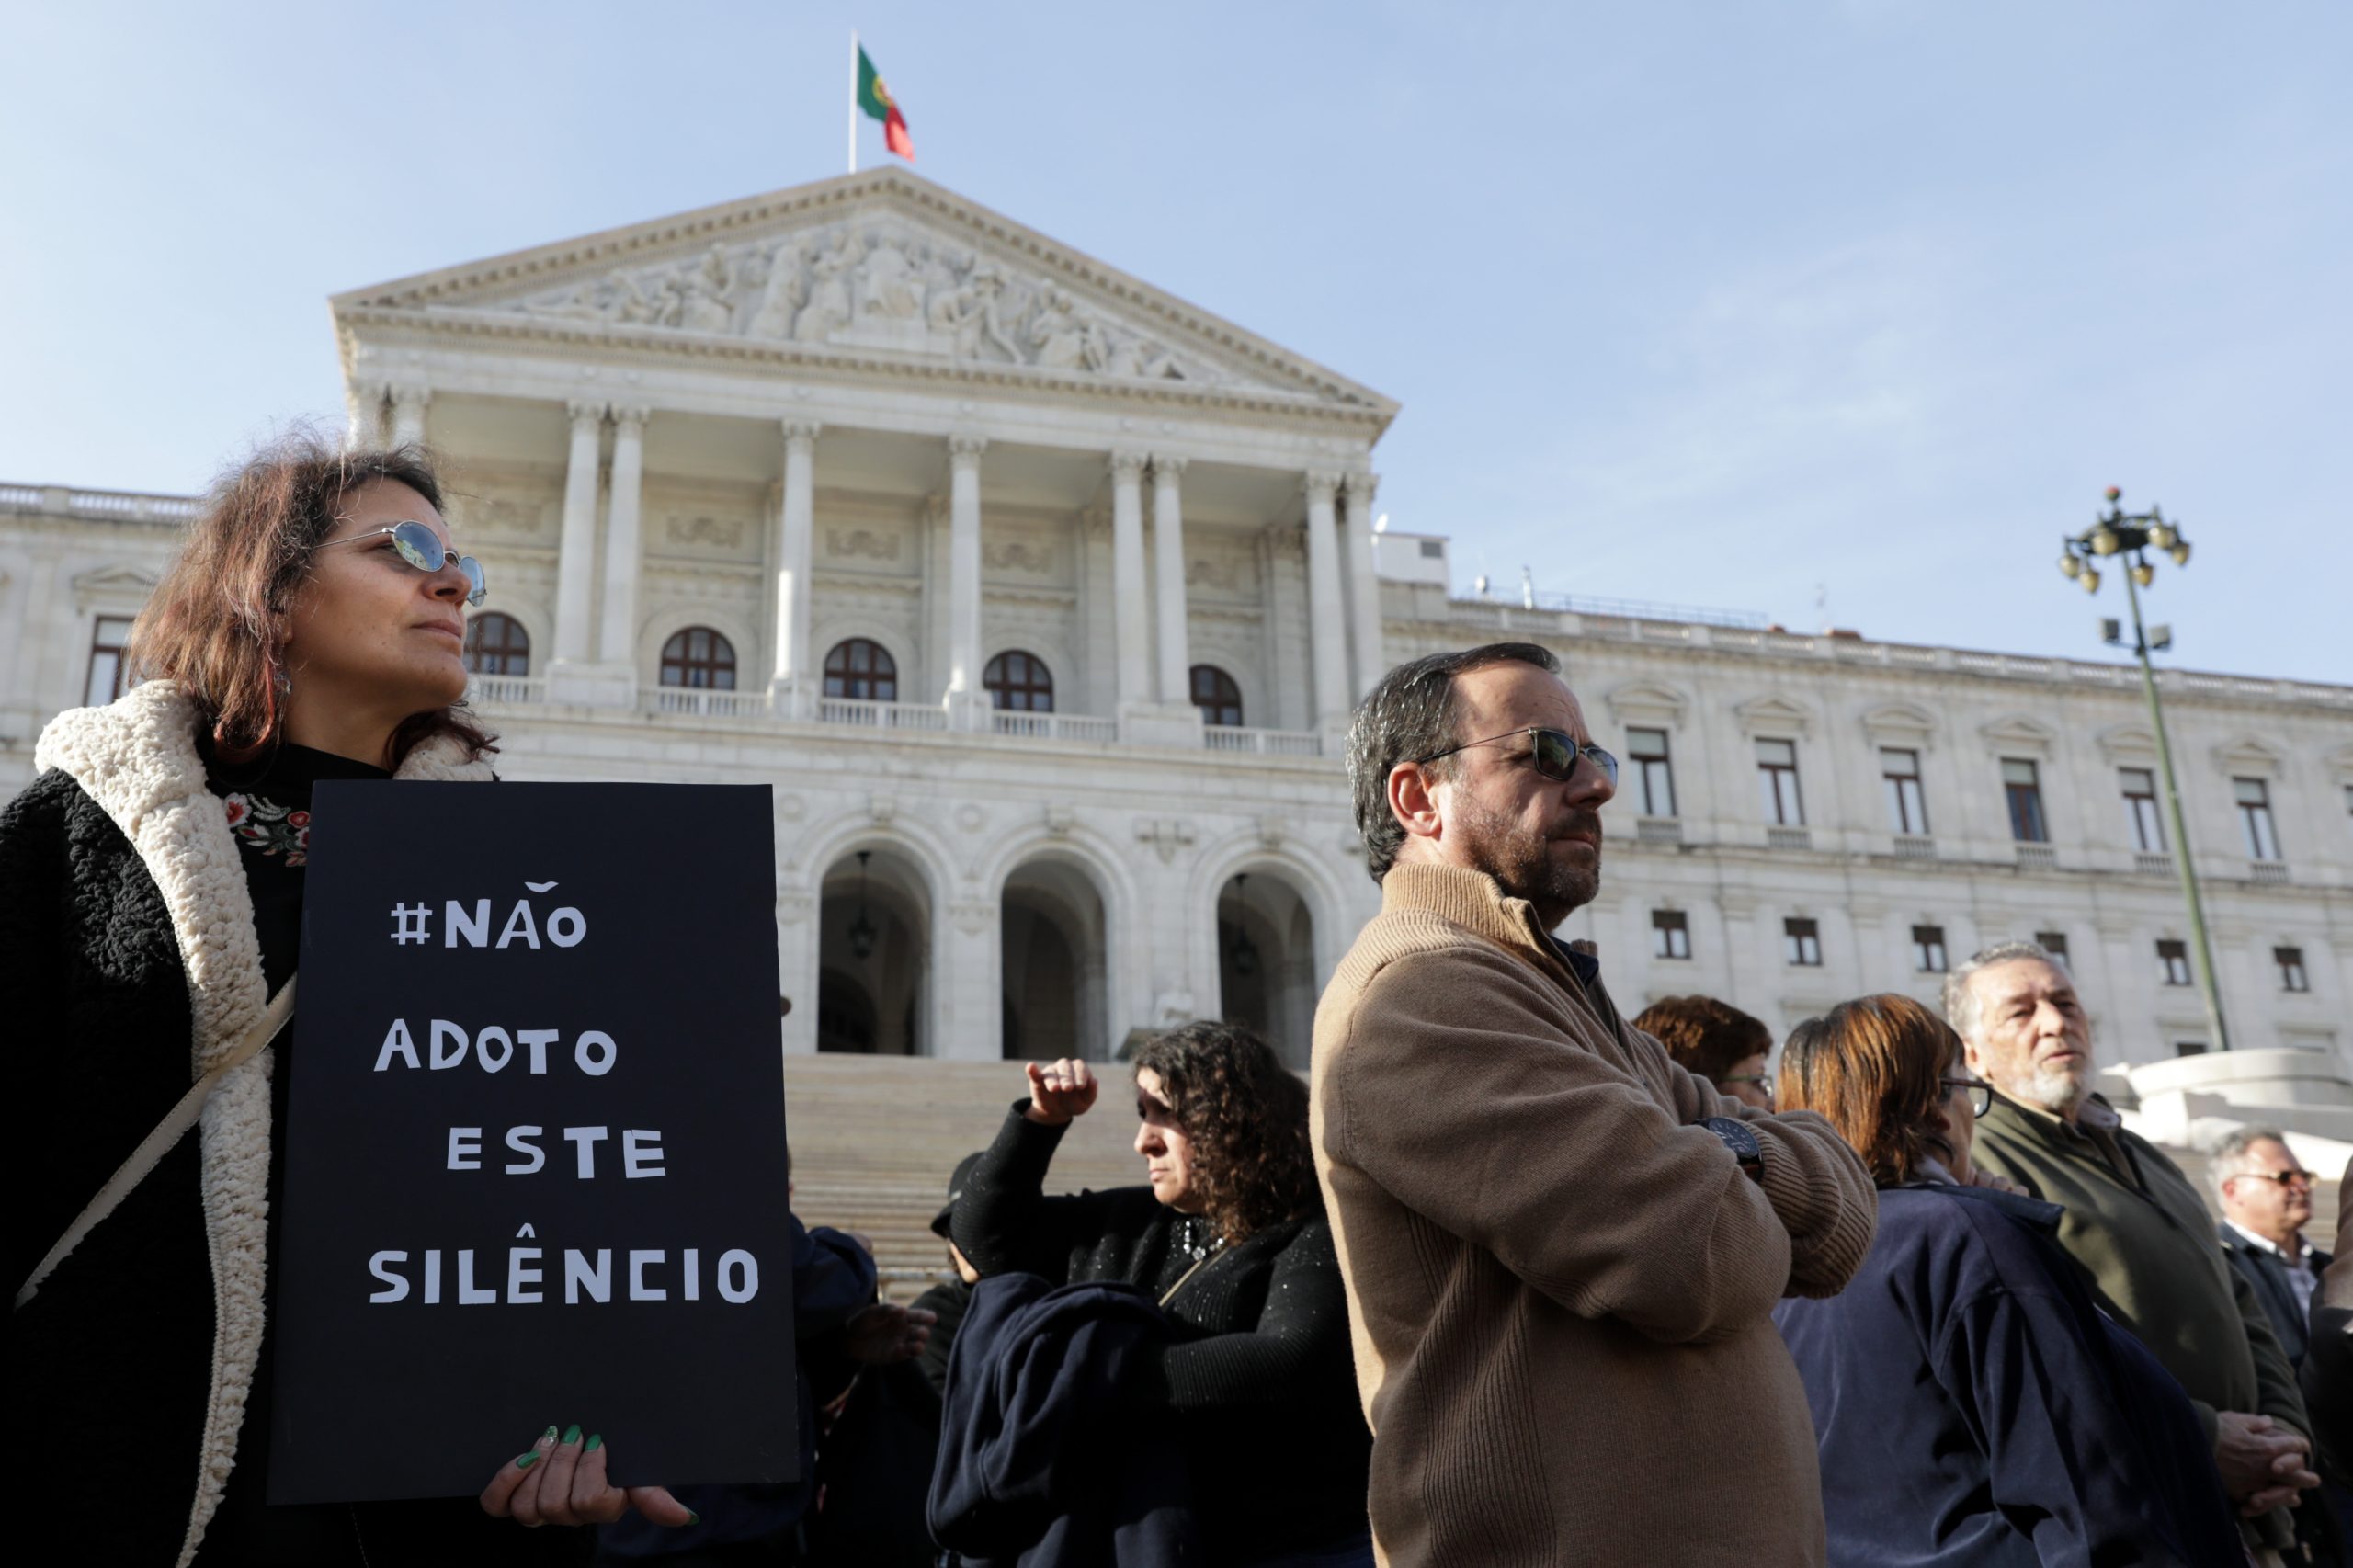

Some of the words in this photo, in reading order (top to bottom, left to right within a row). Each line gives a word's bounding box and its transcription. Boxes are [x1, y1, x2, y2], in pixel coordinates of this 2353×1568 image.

[390, 881, 587, 949] #NÃO
[373, 1018, 617, 1076] ADOTO
[447, 1125, 666, 1179] ESTE
[369, 1222, 759, 1305] SILÊNCIO
